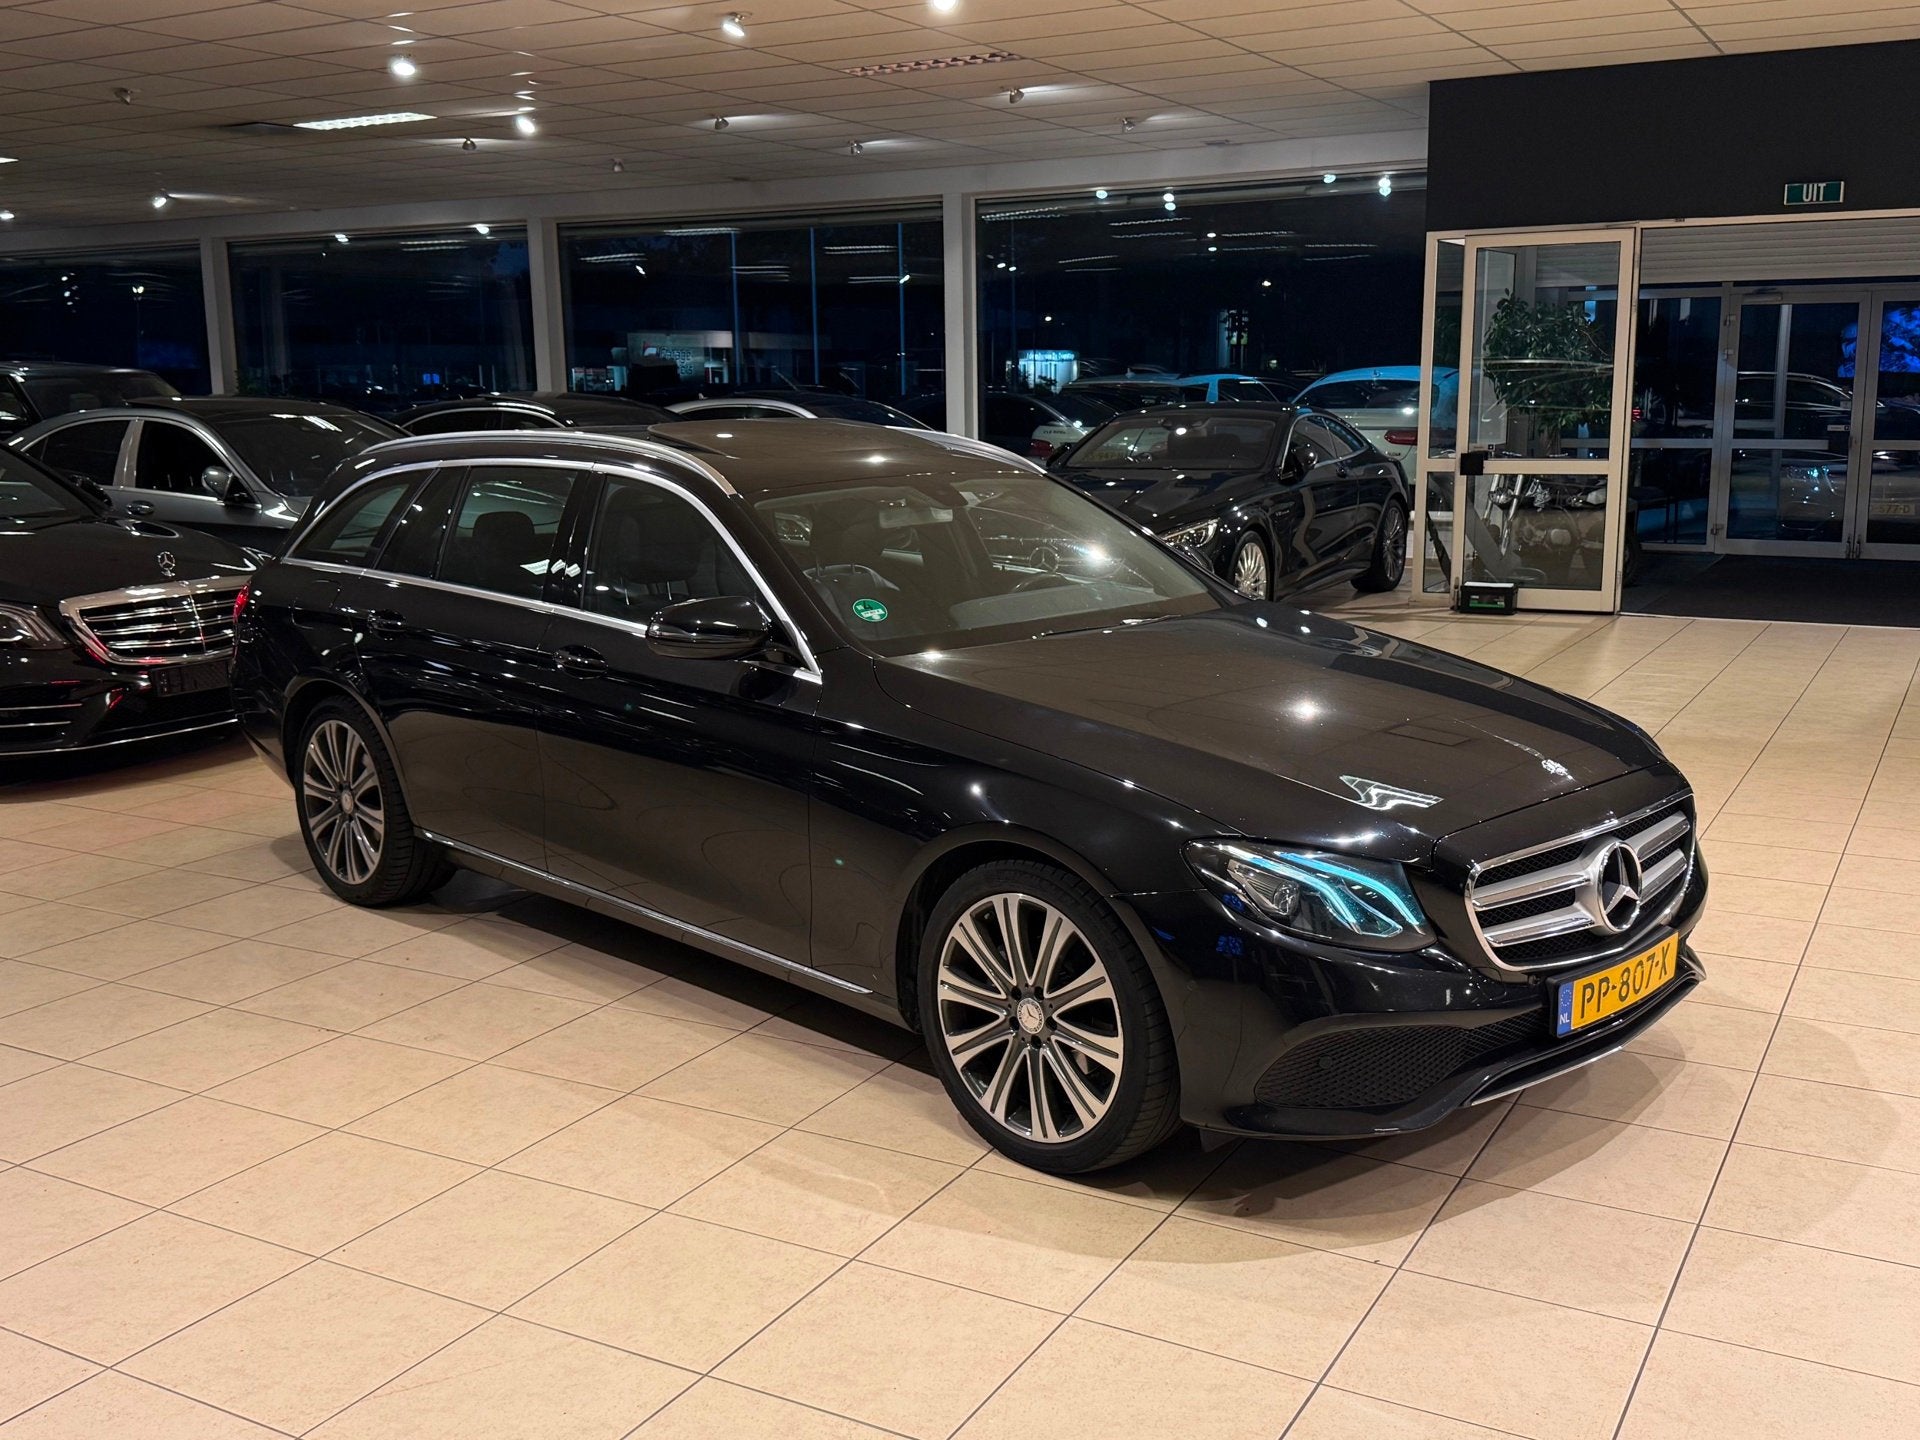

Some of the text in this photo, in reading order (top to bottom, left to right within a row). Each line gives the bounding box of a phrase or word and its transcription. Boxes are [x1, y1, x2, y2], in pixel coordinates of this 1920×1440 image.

[1803, 183, 1826, 202] UIT
[1580, 942, 1671, 1019] PP-807-X
[1559, 1012, 1570, 1025] NL
